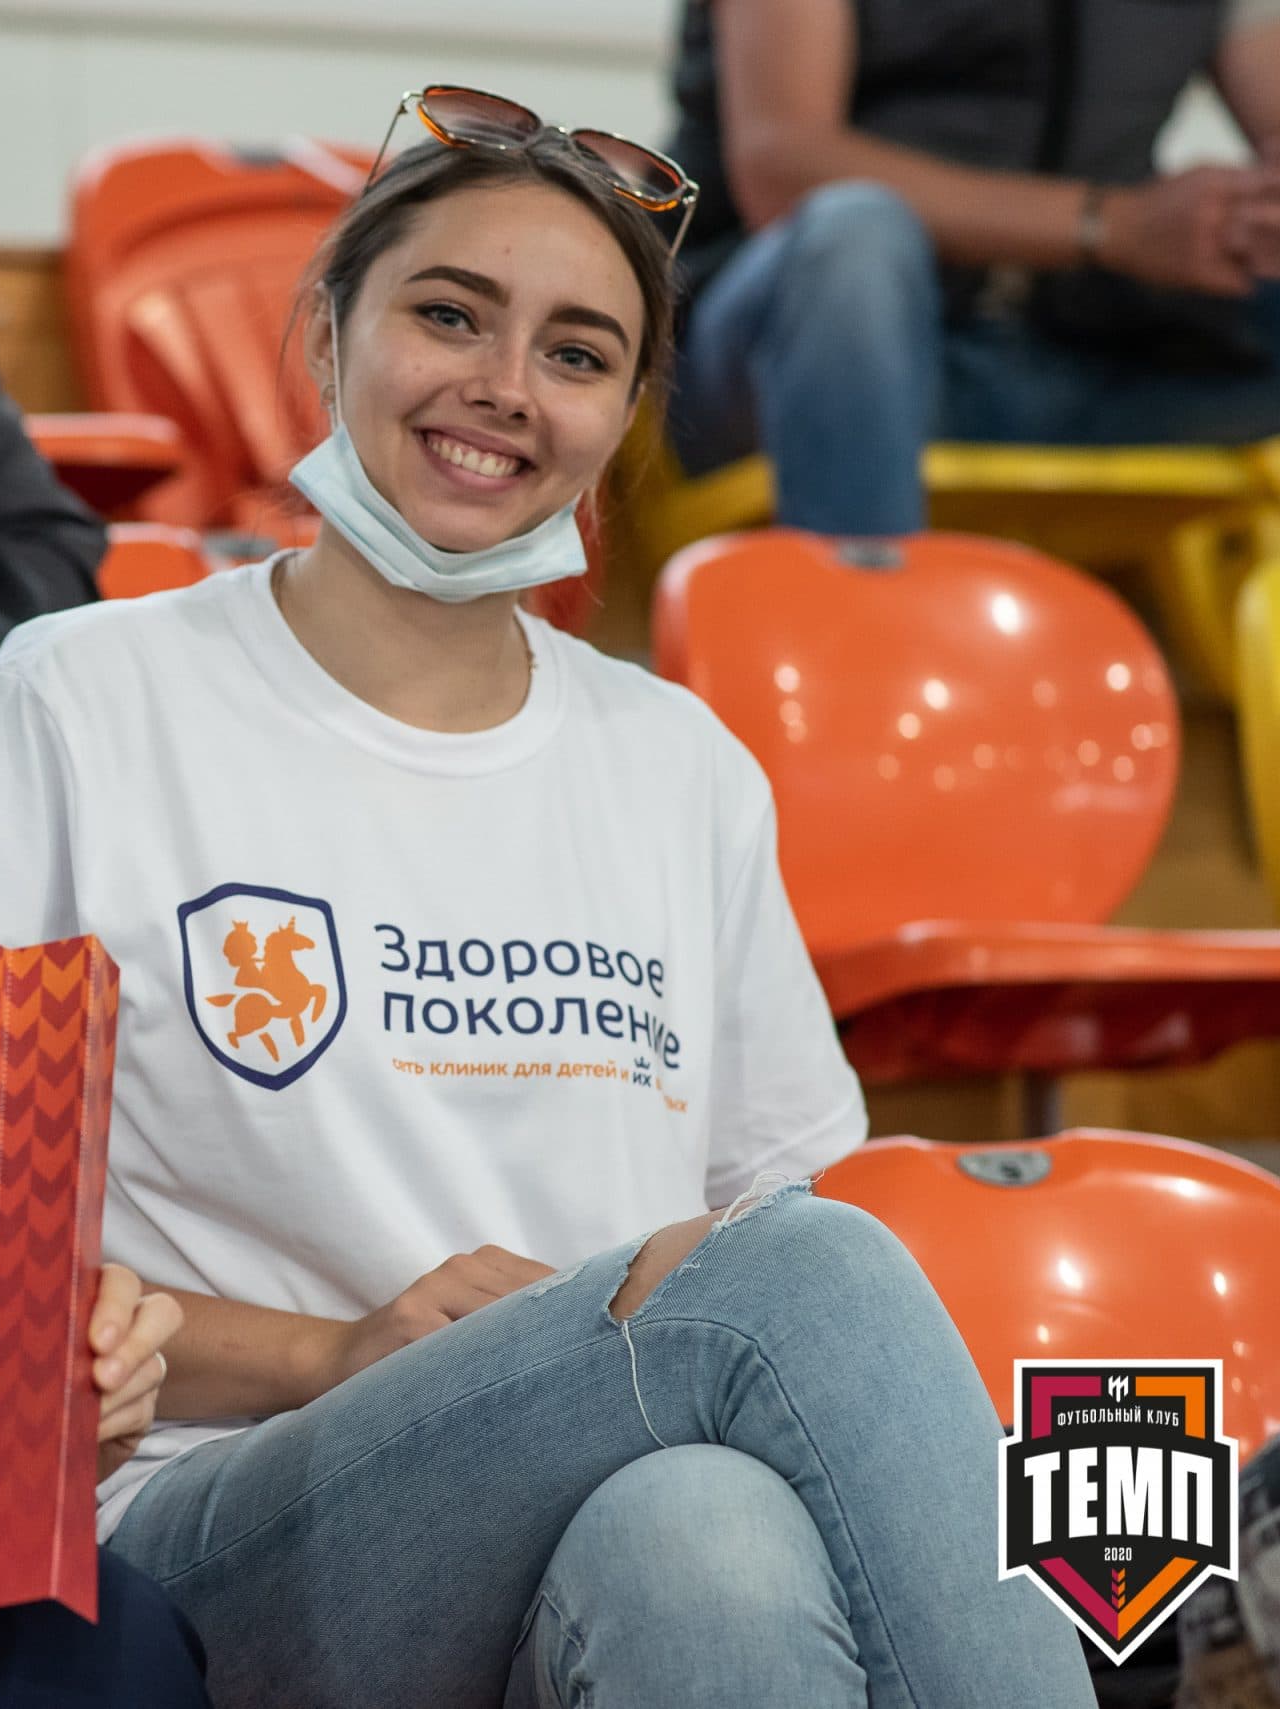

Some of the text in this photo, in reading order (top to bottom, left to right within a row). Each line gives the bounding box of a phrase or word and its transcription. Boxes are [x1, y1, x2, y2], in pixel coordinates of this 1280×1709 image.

[373, 923, 665, 999] Здоровое
[383, 990, 681, 1070] поколение
[430, 1060, 508, 1077] клиник
[513, 1061, 552, 1078] для
[556, 1059, 617, 1079] детей
[632, 1071, 652, 1088] их
